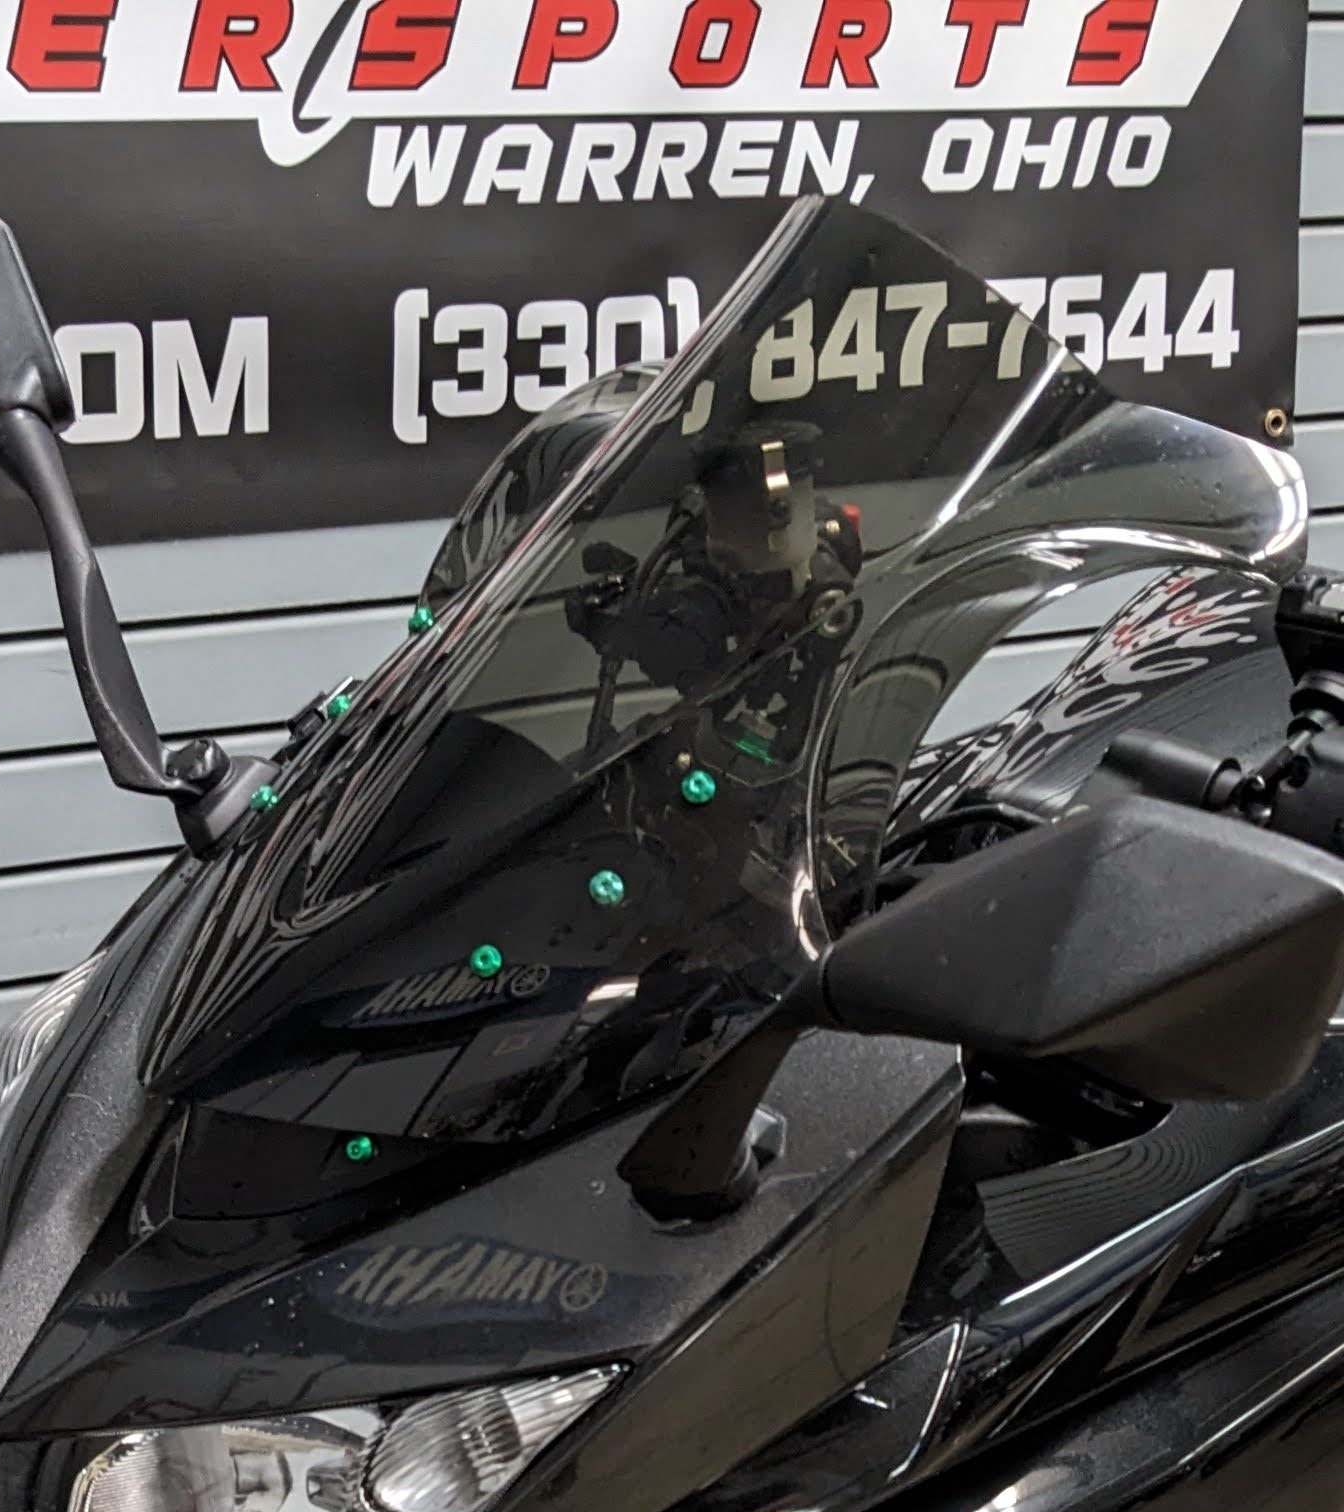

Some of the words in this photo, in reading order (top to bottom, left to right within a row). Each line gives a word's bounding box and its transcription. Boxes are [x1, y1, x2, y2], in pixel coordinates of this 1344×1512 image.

[366, 119, 877, 207] WARREN,
[920, 115, 1174, 193] OHIO
[392, 276, 716, 444] (330)
[749, 268, 1240, 403] 847-7644
